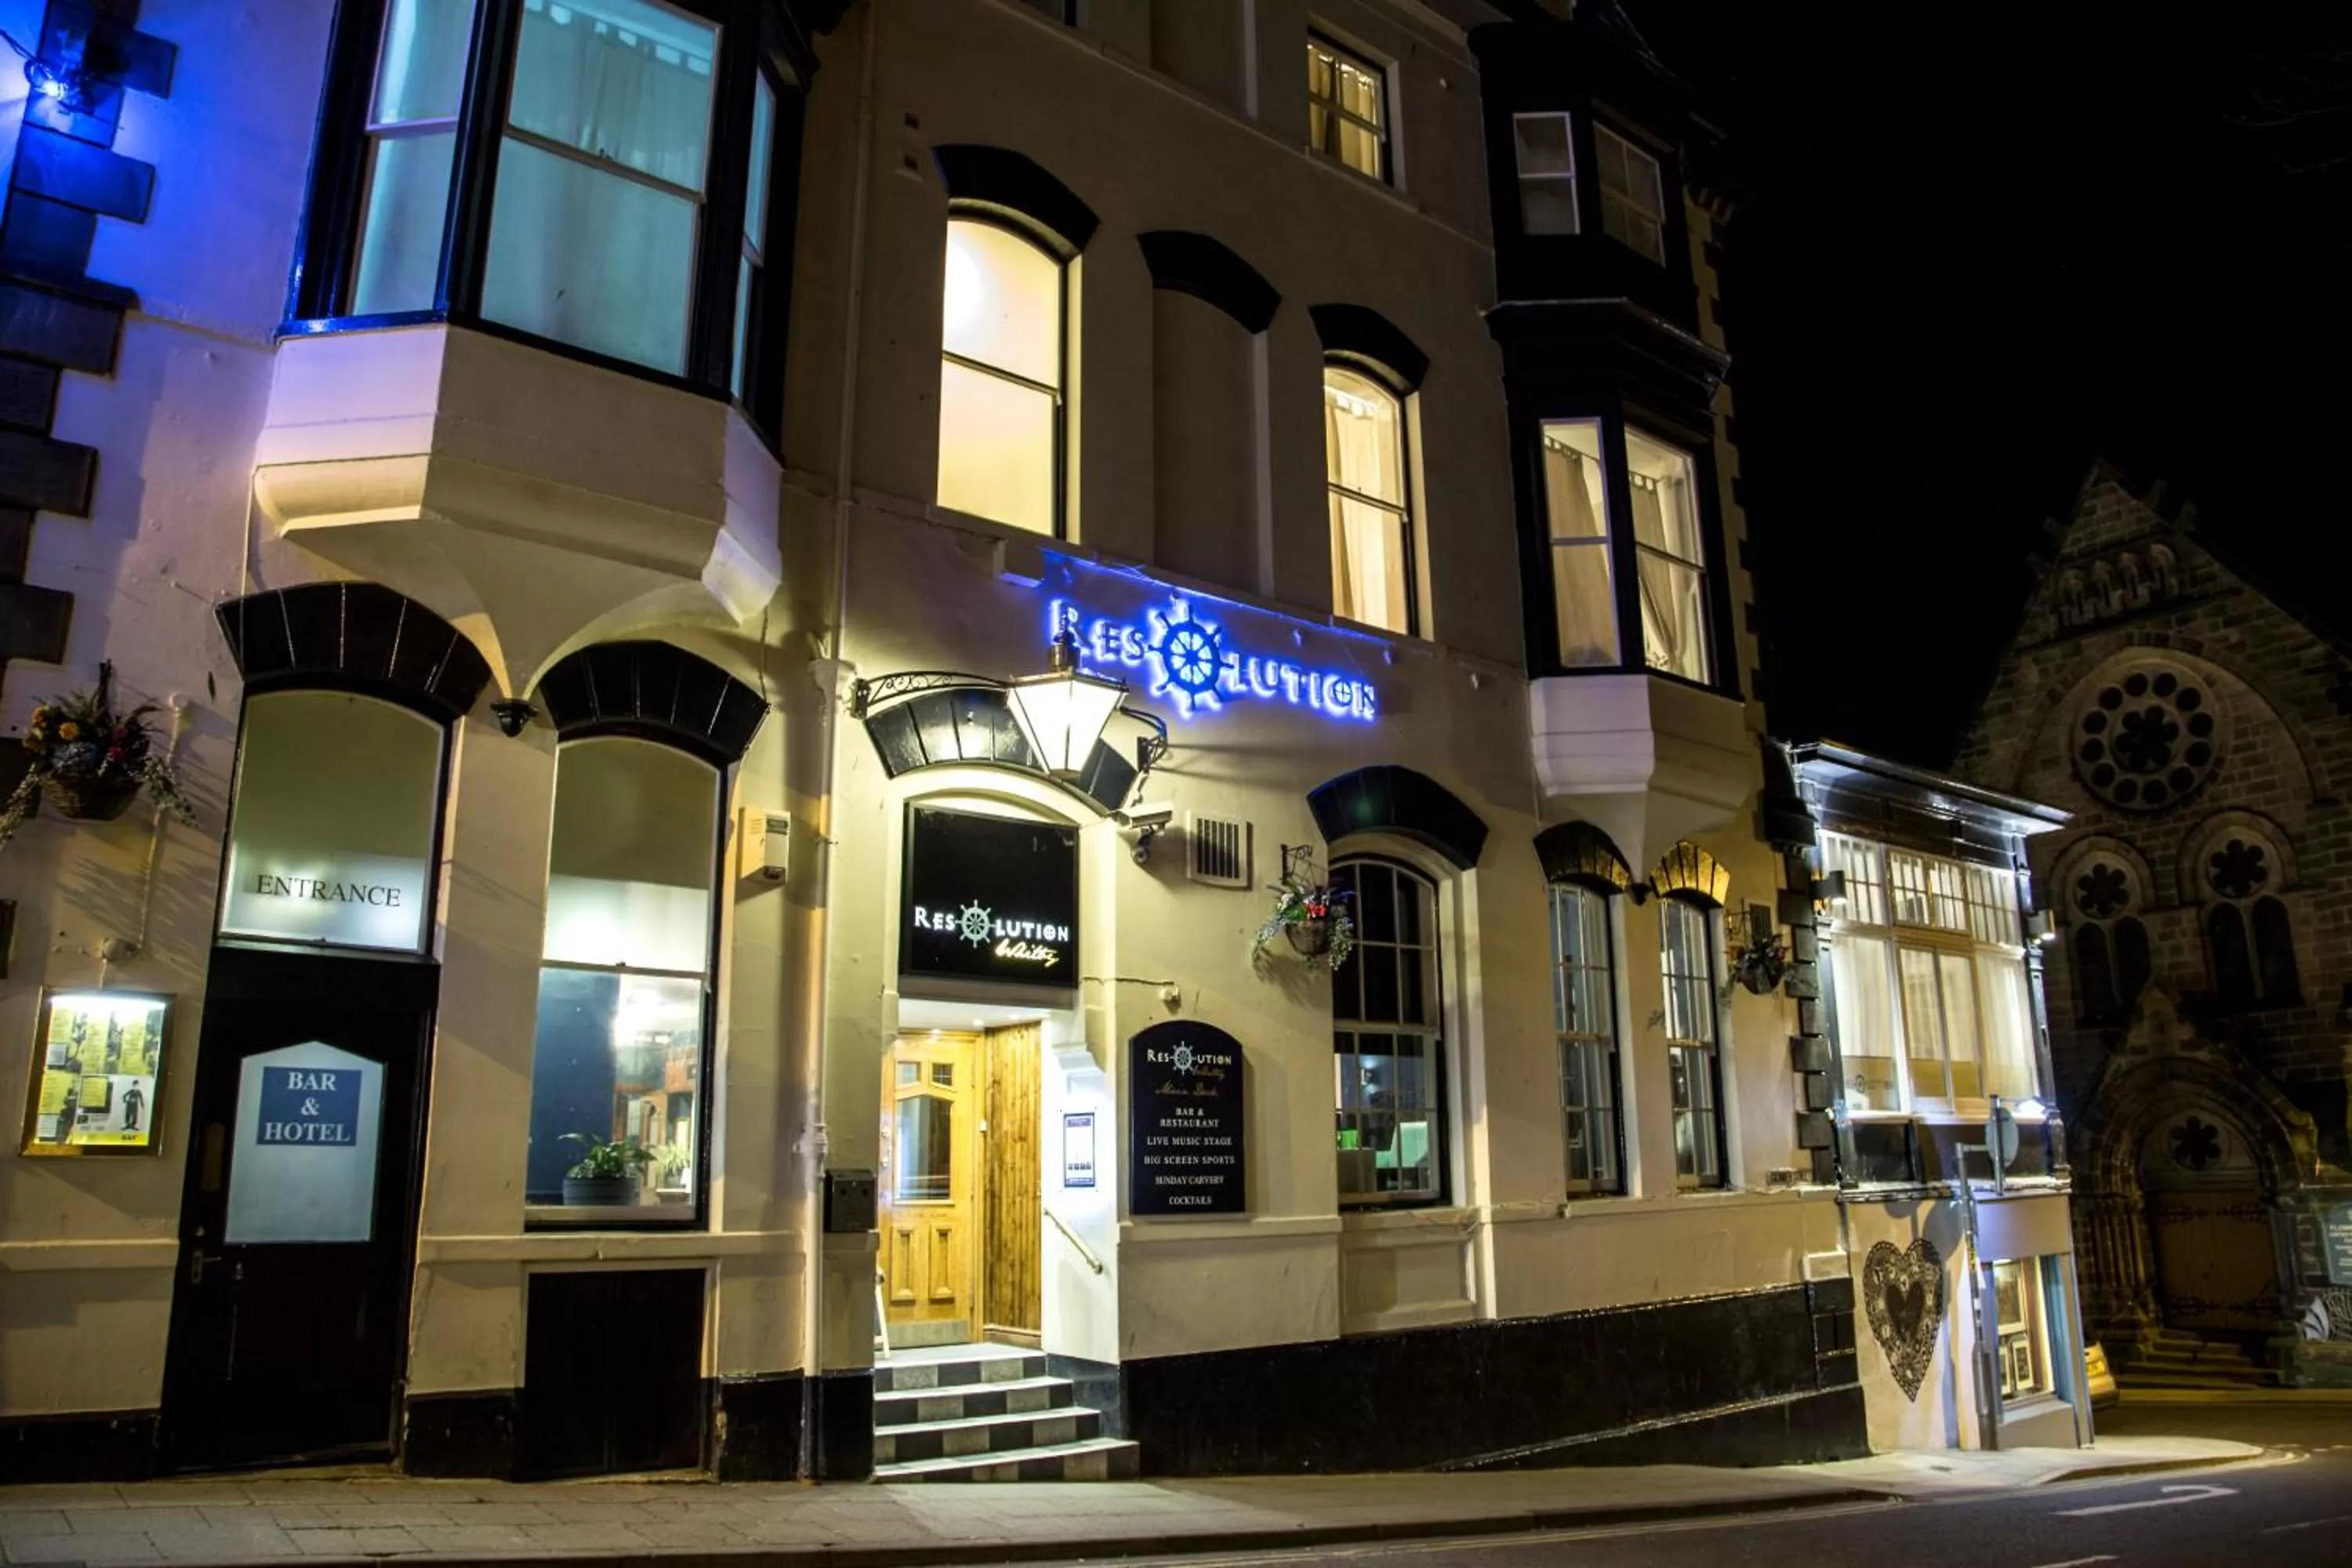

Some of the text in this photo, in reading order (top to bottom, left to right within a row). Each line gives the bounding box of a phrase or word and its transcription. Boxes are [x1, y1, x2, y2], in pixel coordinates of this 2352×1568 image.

[256, 874, 401, 907] ENTRANCE
[288, 1071, 336, 1091] BAR
[300, 1097, 320, 1116] &
[1175, 1107, 1194, 1116] BAR
[1160, 1118, 1219, 1127] RESTAURANT
[263, 1121, 350, 1142] HOTEL
[1147, 1136, 1232, 1145] LIVE MUSIC STAGE
[1144, 1155, 1236, 1164] BIG SCREEN SPORTS
[1155, 1175, 1224, 1185] SUNDAY CARVERY
[1168, 1196, 1213, 1205] COCKTAILS
